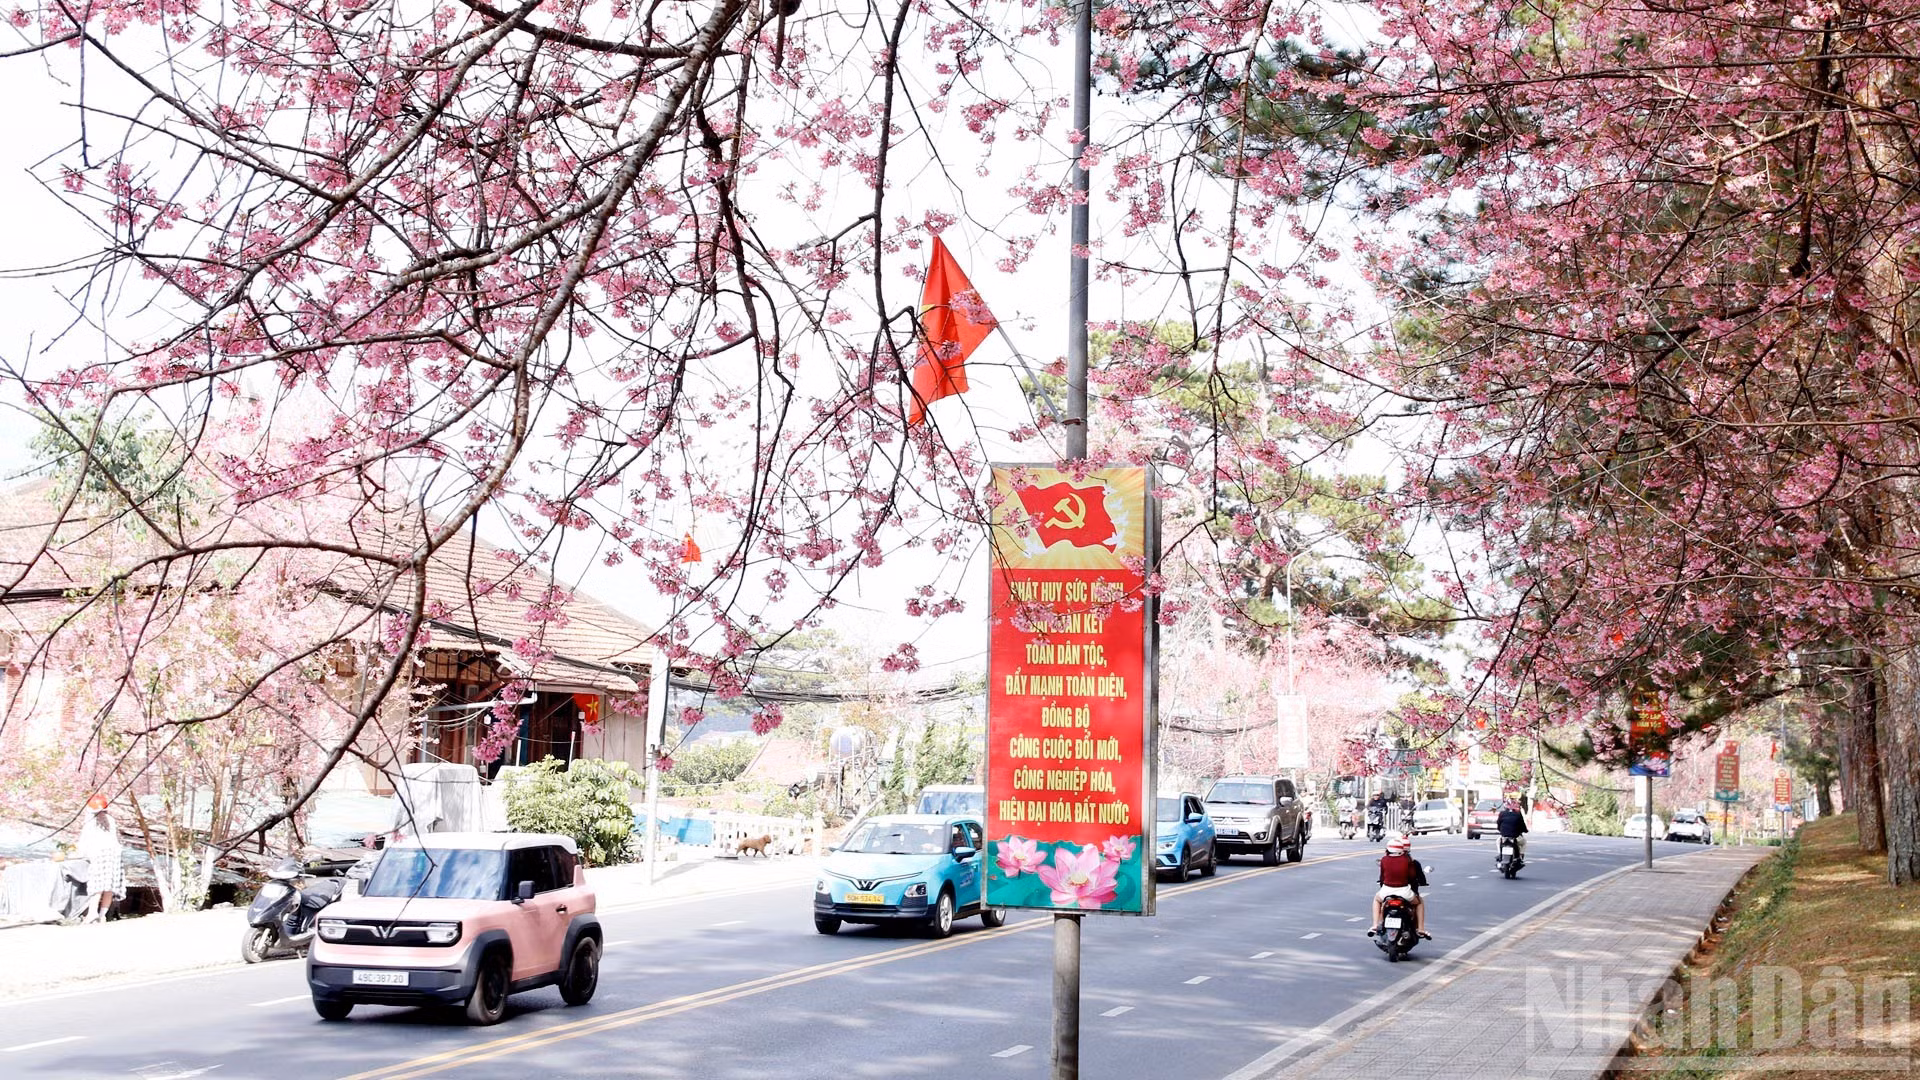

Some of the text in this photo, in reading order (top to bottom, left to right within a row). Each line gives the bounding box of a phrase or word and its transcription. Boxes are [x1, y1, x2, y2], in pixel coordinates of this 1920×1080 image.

[1011, 577, 1124, 603] PHÁT HUY SỨC MH
[1051, 609, 1080, 633] ÀN
[1057, 640, 1080, 665] DÂN
[1083, 640, 1108, 670] TỘC,
[1006, 667, 1128, 702] ĐẨY MẠNH TOÀN DIỆN,
[1042, 700, 1090, 731] ĐỒNG BỘ
[1010, 731, 1122, 763] CÔNG CUỘC ĐỔI MỚI,
[1014, 765, 1116, 795] CÔNG NGHIỆP HÓA,
[1000, 796, 1130, 826] HIỆN ĐẠI HÓA ĐẤT NƯỚC
